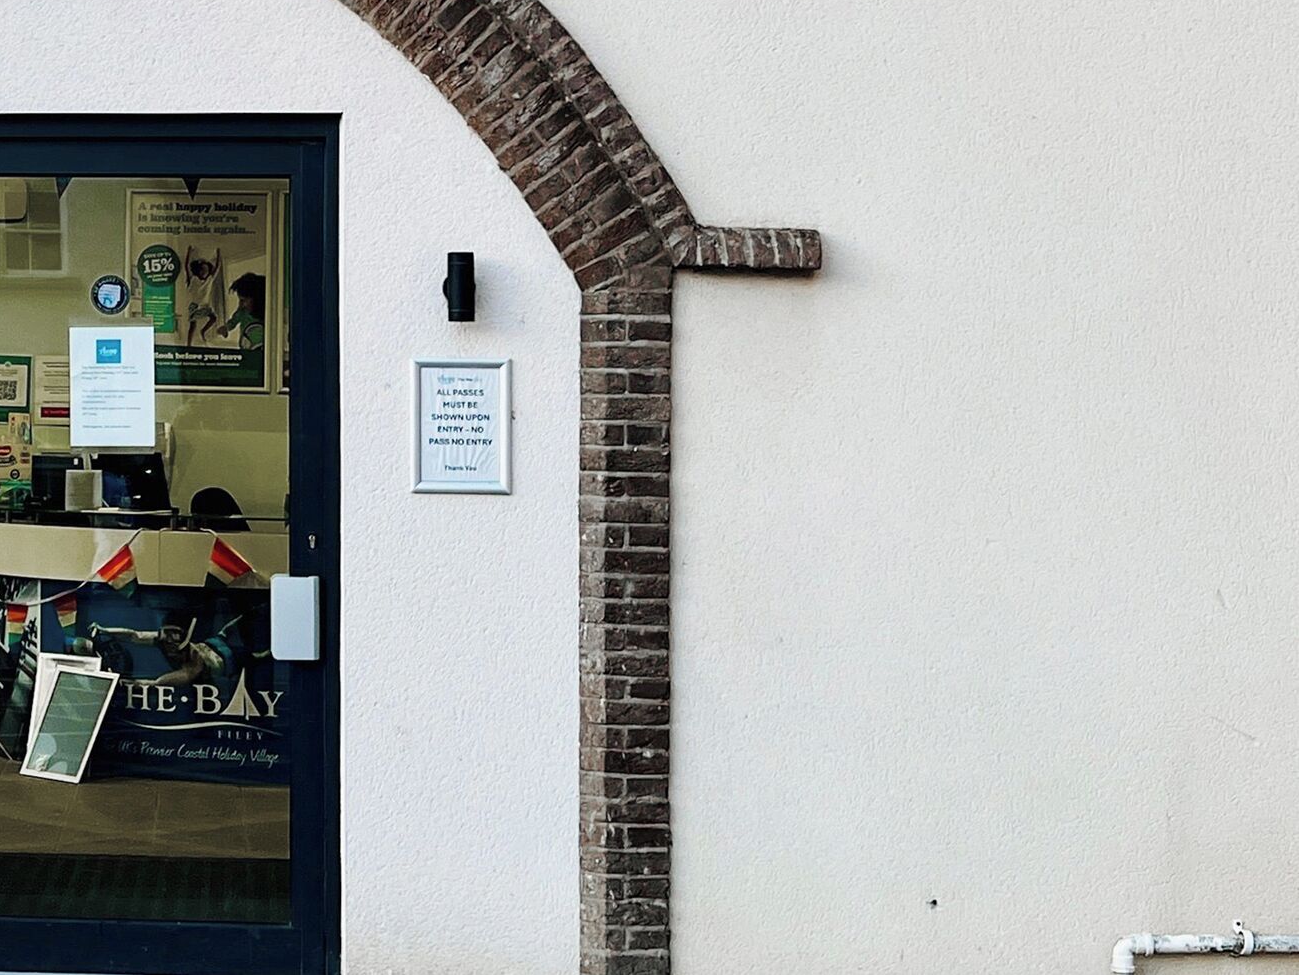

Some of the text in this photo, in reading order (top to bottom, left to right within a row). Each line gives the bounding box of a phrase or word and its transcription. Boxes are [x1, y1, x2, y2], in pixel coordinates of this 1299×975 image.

[138, 202, 258, 214] A real happy holiday
[150, 213, 200, 224] knowing
[203, 214, 239, 224] you're
[138, 225, 181, 235] coming
[183, 225, 211, 234] back
[143, 257, 175, 274] 15%
[175, 352, 203, 360] before
[220, 353, 243, 361] leave
[453, 389, 484, 397] PASSES
[471, 426, 484, 434] NO
[451, 438, 465, 446] NO
[121, 679, 177, 713] HE
[217, 729, 264, 741] FILEY
[140, 740, 175, 757] Premier
[177, 743, 209, 760] Coastal
[212, 746, 247, 767] Holiday
[250, 749, 280, 769] Village
